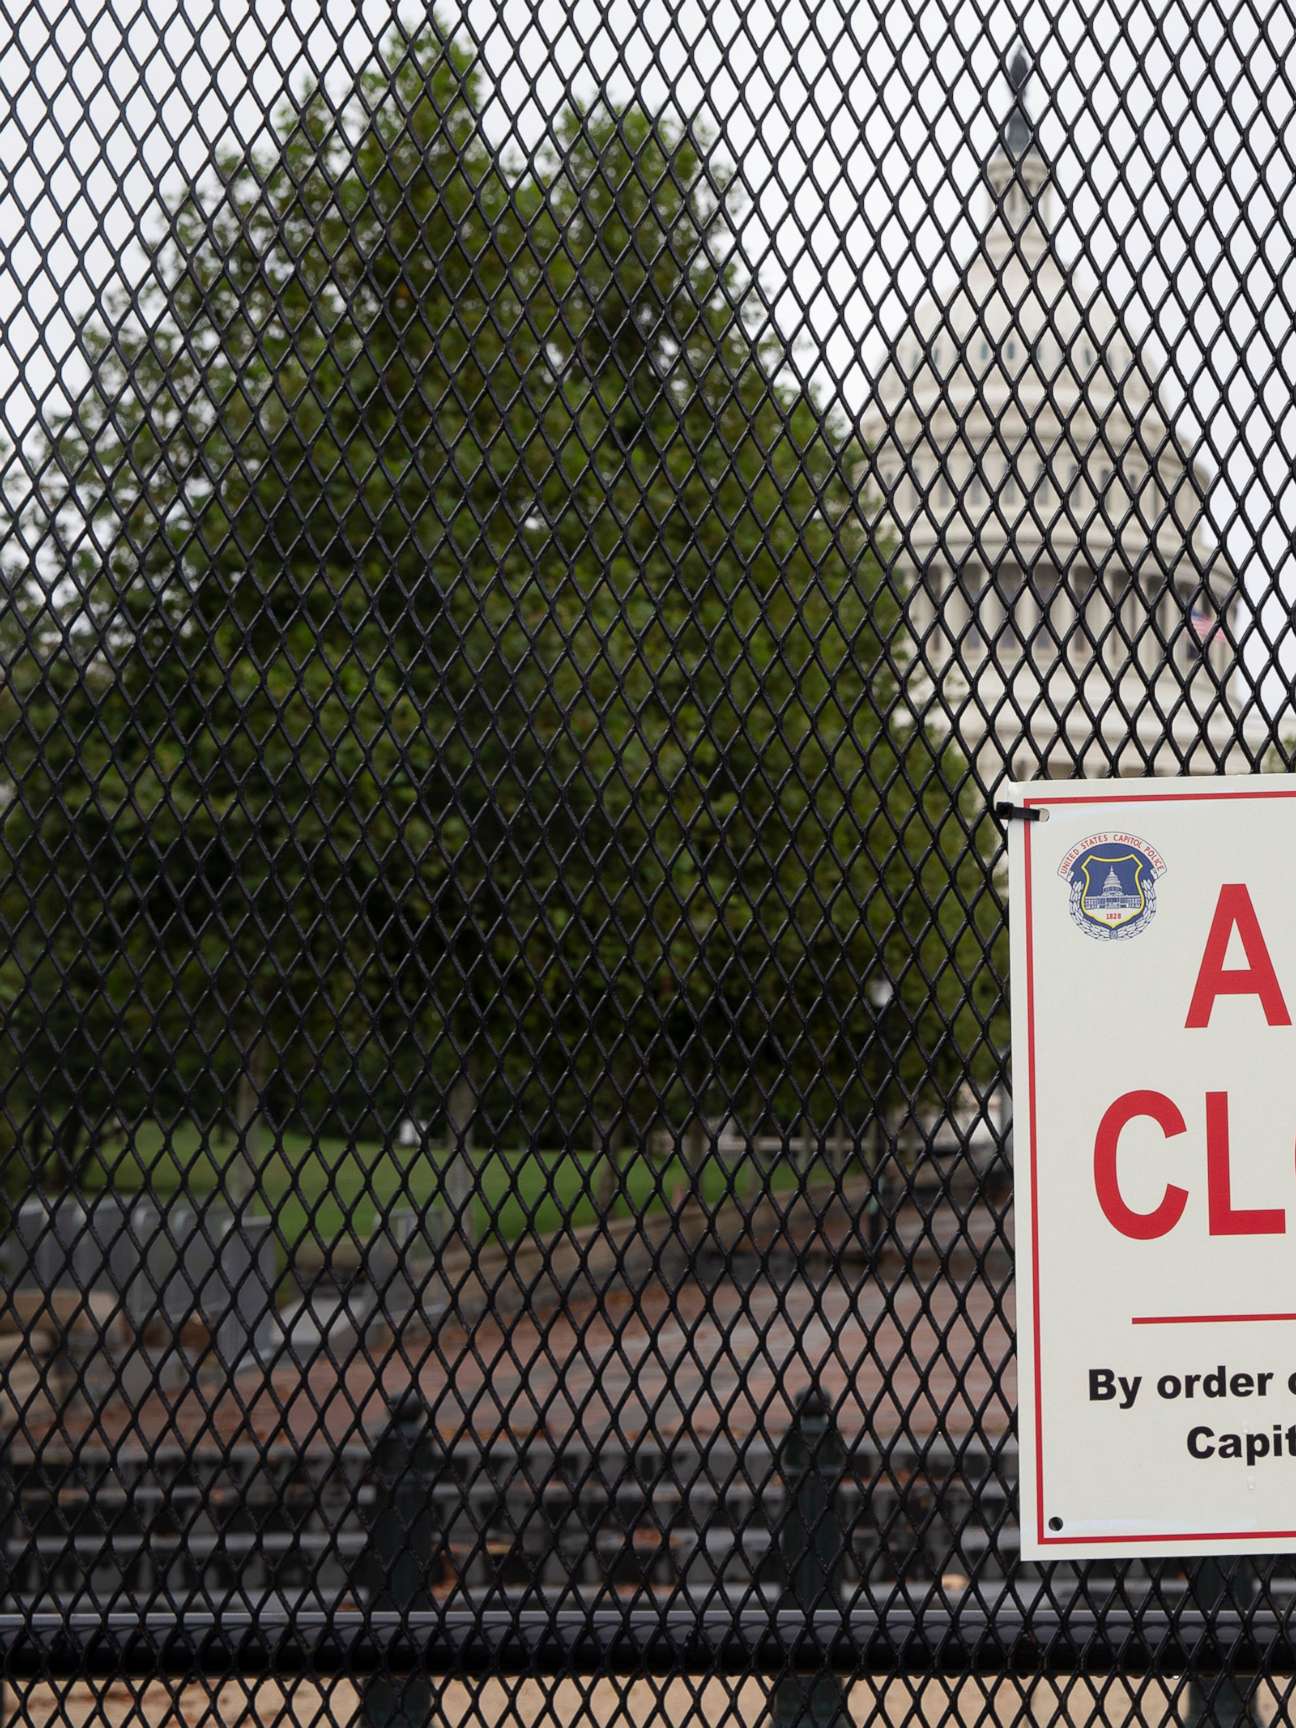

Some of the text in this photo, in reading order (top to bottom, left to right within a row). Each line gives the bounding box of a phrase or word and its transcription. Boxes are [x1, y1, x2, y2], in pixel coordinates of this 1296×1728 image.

[1060, 834, 1165, 874] UNITED STATES CAPITOL POLICE
[1089, 1369, 1142, 1409] By
[1157, 1366, 1273, 1399] order
